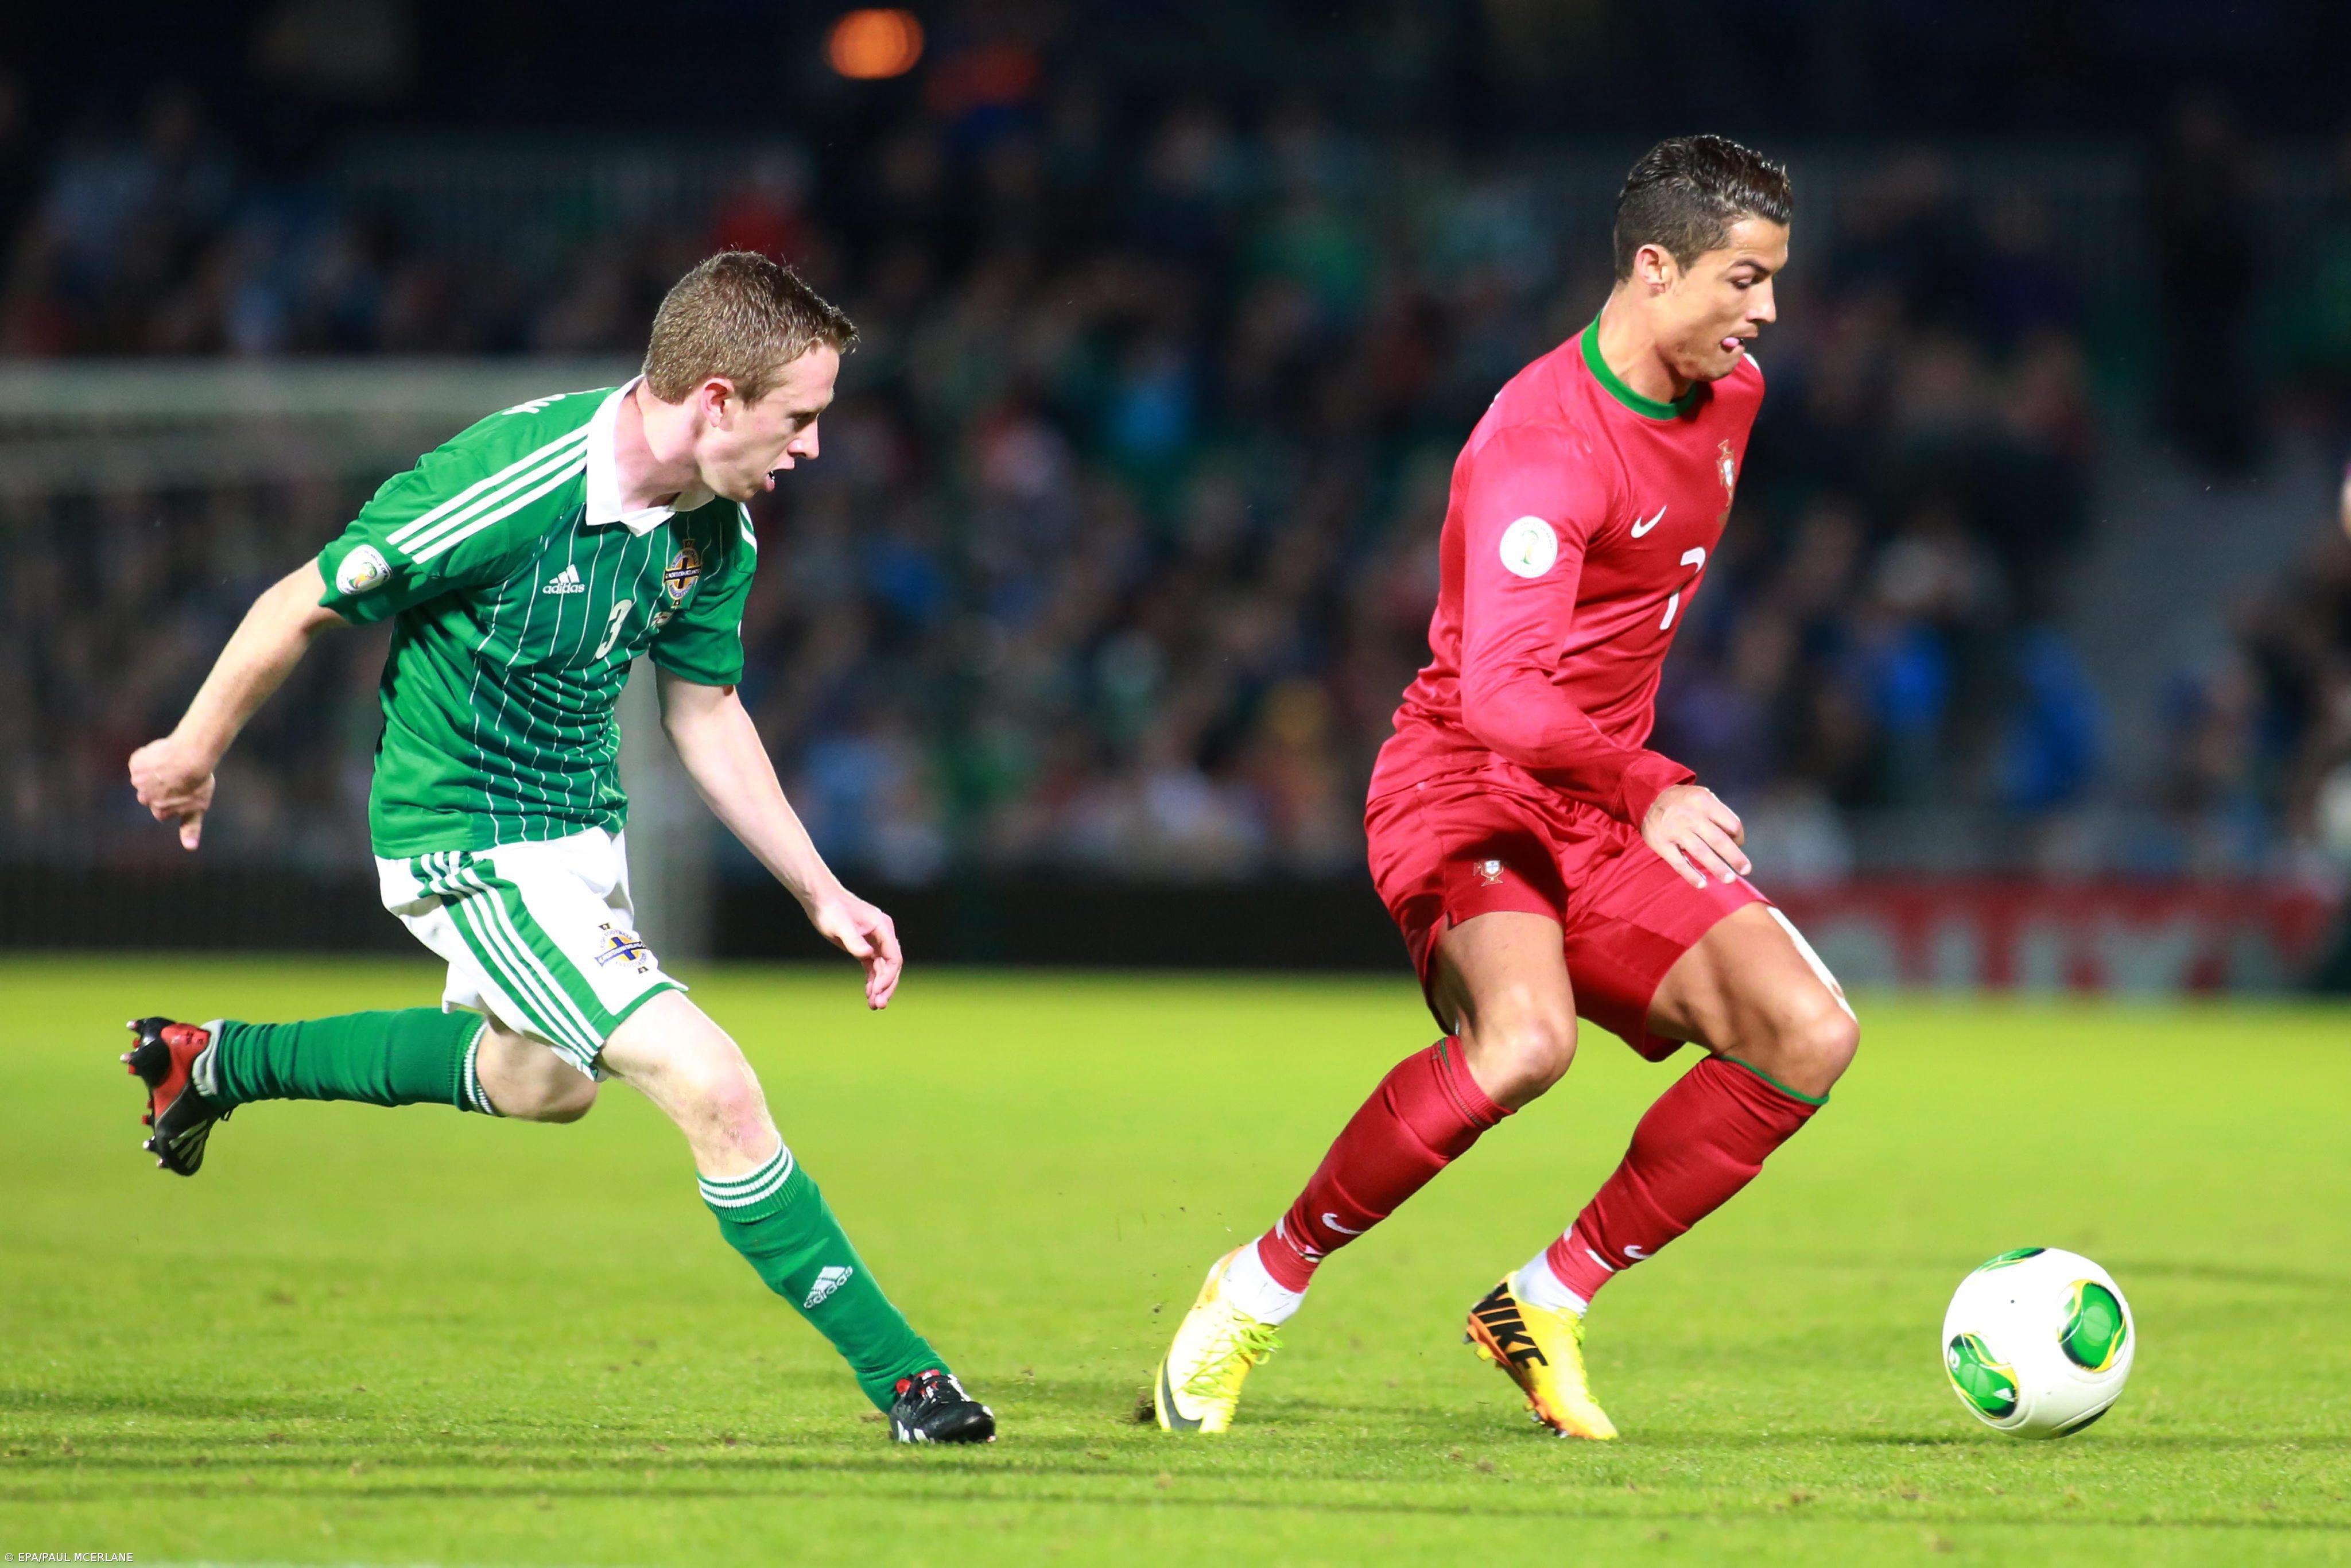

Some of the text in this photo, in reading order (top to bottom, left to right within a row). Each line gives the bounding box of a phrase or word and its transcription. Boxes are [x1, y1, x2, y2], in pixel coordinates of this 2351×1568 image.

[542, 583, 585, 594] adidas
[1659, 546, 1706, 630] 7
[595, 599, 632, 659] 3
[804, 1266, 853, 1309] adidas
[1471, 1281, 1549, 1369] NIKE
